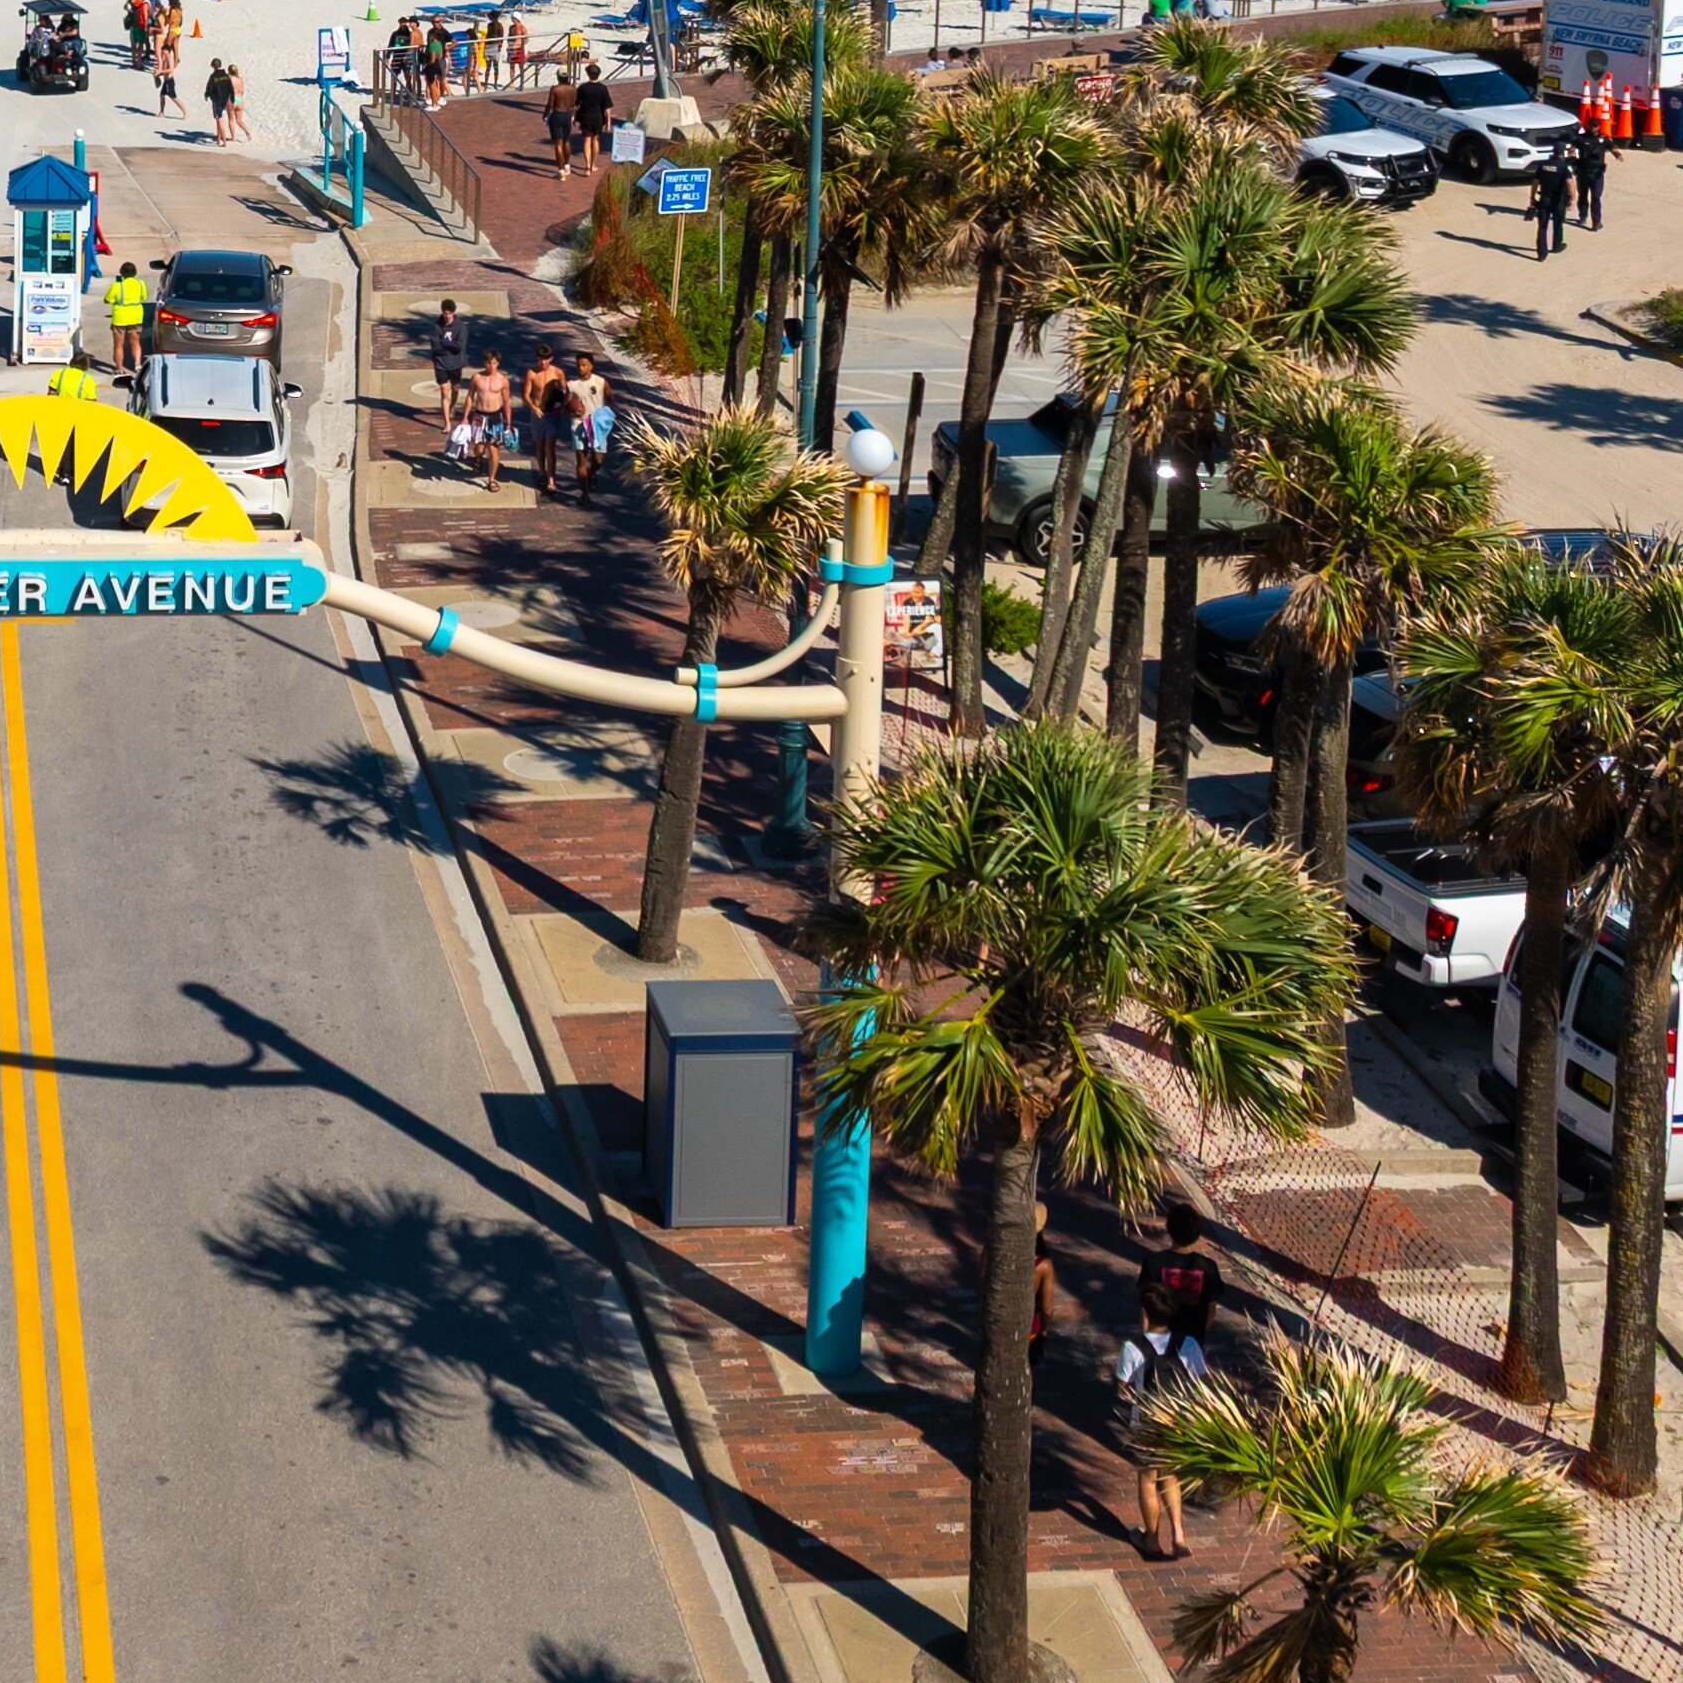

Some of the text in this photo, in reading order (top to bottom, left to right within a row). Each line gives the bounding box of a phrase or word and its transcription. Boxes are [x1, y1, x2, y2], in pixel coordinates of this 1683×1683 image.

[1547, 2, 1654, 31] POLICE
[1554, 28, 1644, 52] NEW SMYRNA BEACH
[1548, 45, 1564, 56] 911
[665, 173, 707, 184] TRAFFIC FREE
[674, 183, 695, 191] BEACH
[681, 192, 701, 201] MILES
[73, 573, 293, 613] AVENUE
